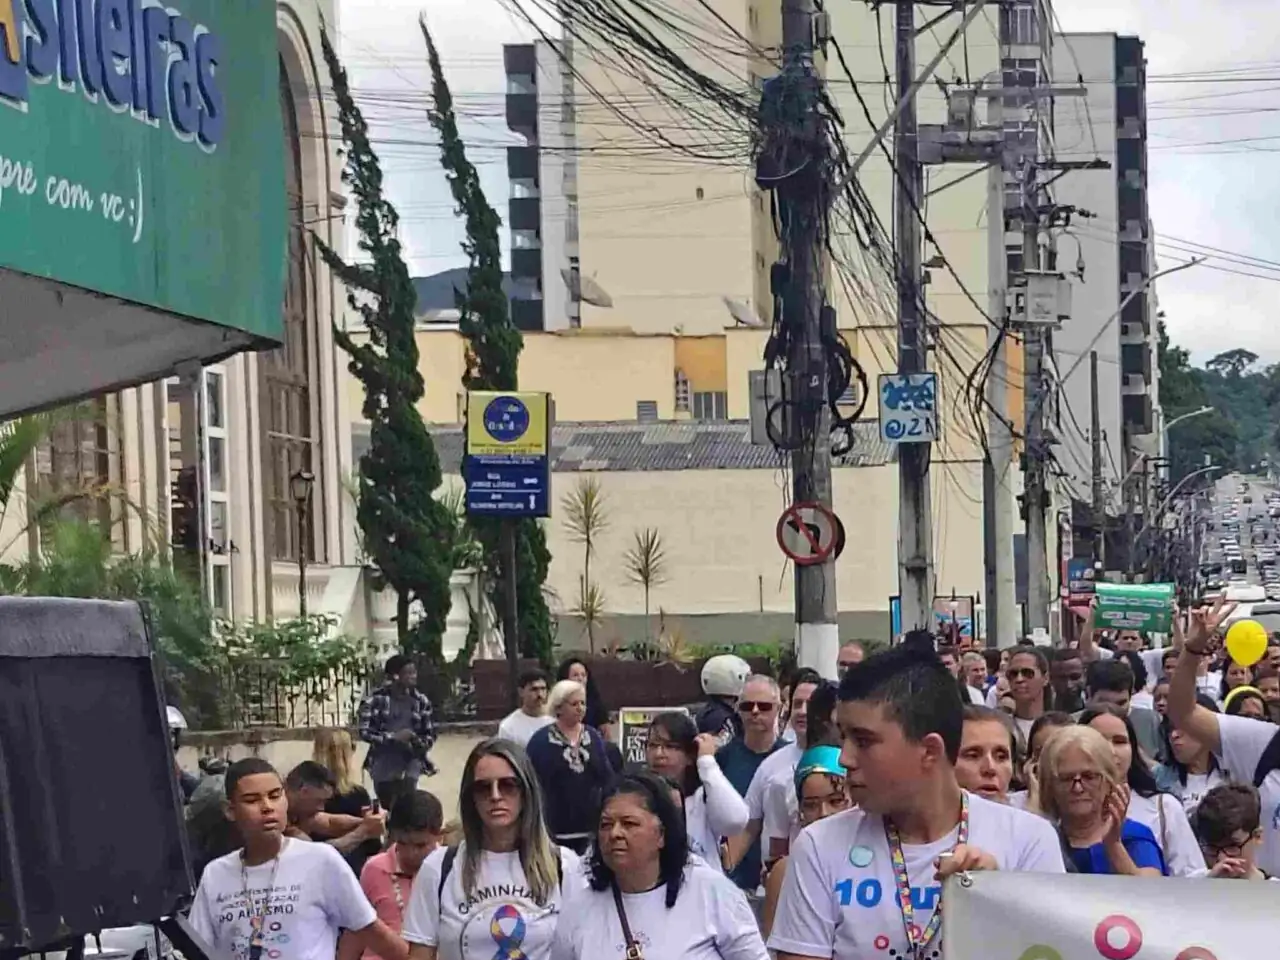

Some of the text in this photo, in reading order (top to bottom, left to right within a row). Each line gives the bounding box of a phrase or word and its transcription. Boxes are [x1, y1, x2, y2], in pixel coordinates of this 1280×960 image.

[0, 154, 37, 207] pre
[46, 176, 93, 212] com
[835, 878, 882, 908] 10
